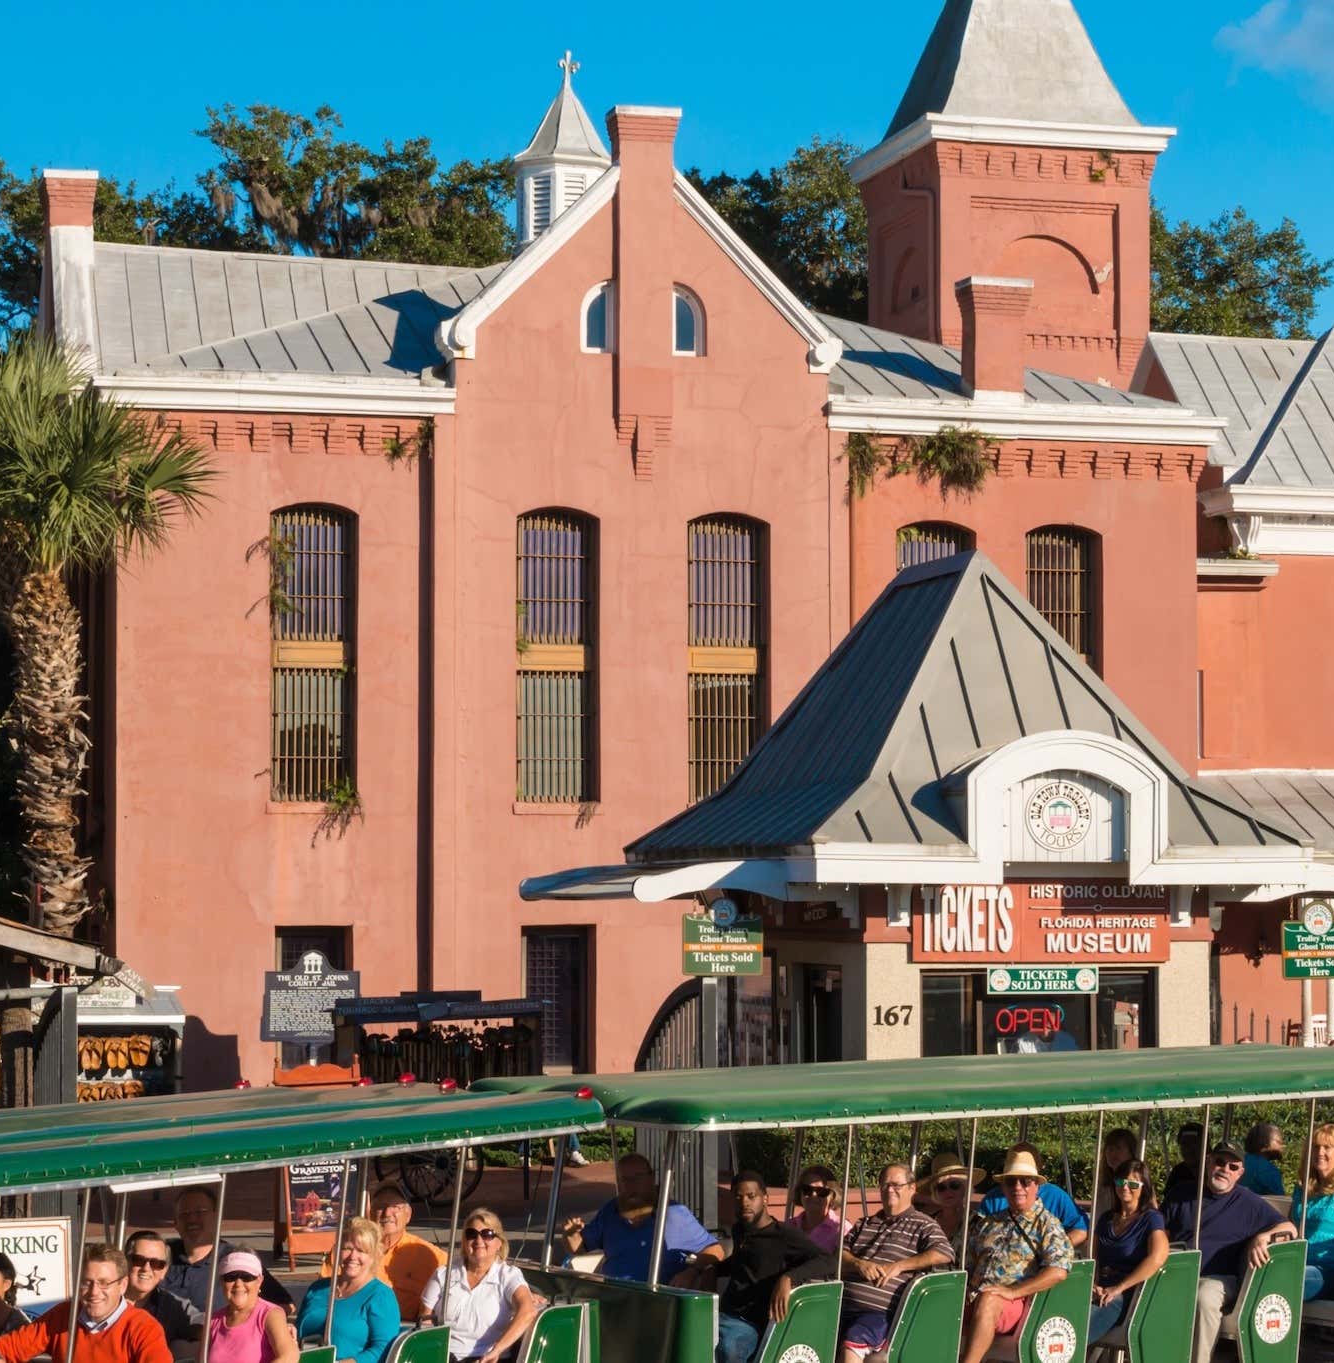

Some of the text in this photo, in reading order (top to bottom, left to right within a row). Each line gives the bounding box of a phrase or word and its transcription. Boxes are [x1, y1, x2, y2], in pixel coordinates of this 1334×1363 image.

[1029, 884, 1165, 899] HISTORIC OLD JAIL
[921, 885, 1014, 953] TICKETS
[1040, 917, 1158, 929] FLORIDA HERITAGE
[724, 935, 747, 943] Tours
[1045, 932, 1152, 954] MUSEUM
[693, 952, 753, 962] Tickets Sold
[1294, 958, 1325, 967] Tickets
[711, 963, 736, 973] Here
[1309, 967, 1330, 976] Here
[1018, 969, 1069, 980] TICKETS
[1011, 980, 1043, 991] SOLD
[1045, 980, 1076, 991] HERE
[873, 1005, 914, 1026] 167
[995, 1008, 1061, 1033] OPEN
